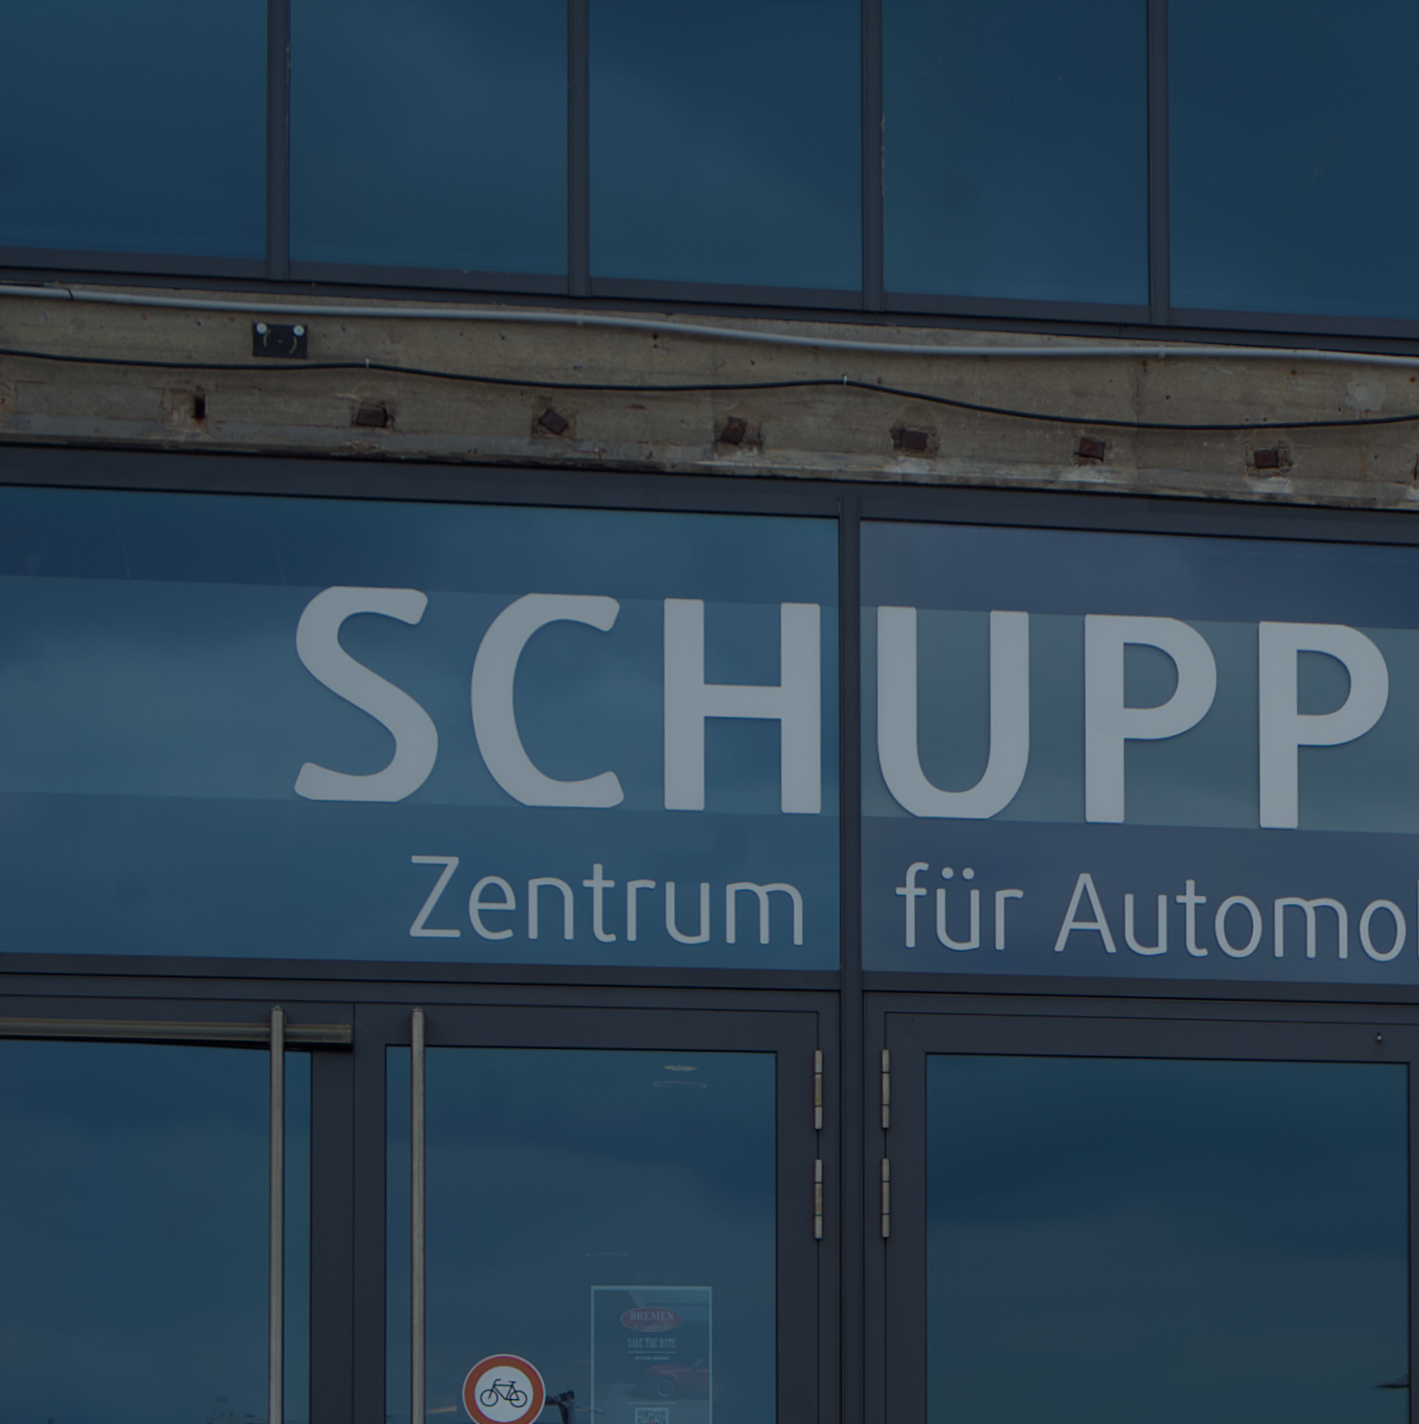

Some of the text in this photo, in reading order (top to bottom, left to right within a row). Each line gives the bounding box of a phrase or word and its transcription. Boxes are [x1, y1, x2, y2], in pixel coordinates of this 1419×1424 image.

[410, 855, 803, 945] Zentrum
[896, 861, 1024, 952] für
[630, 1311, 674, 1321] BREMEN
